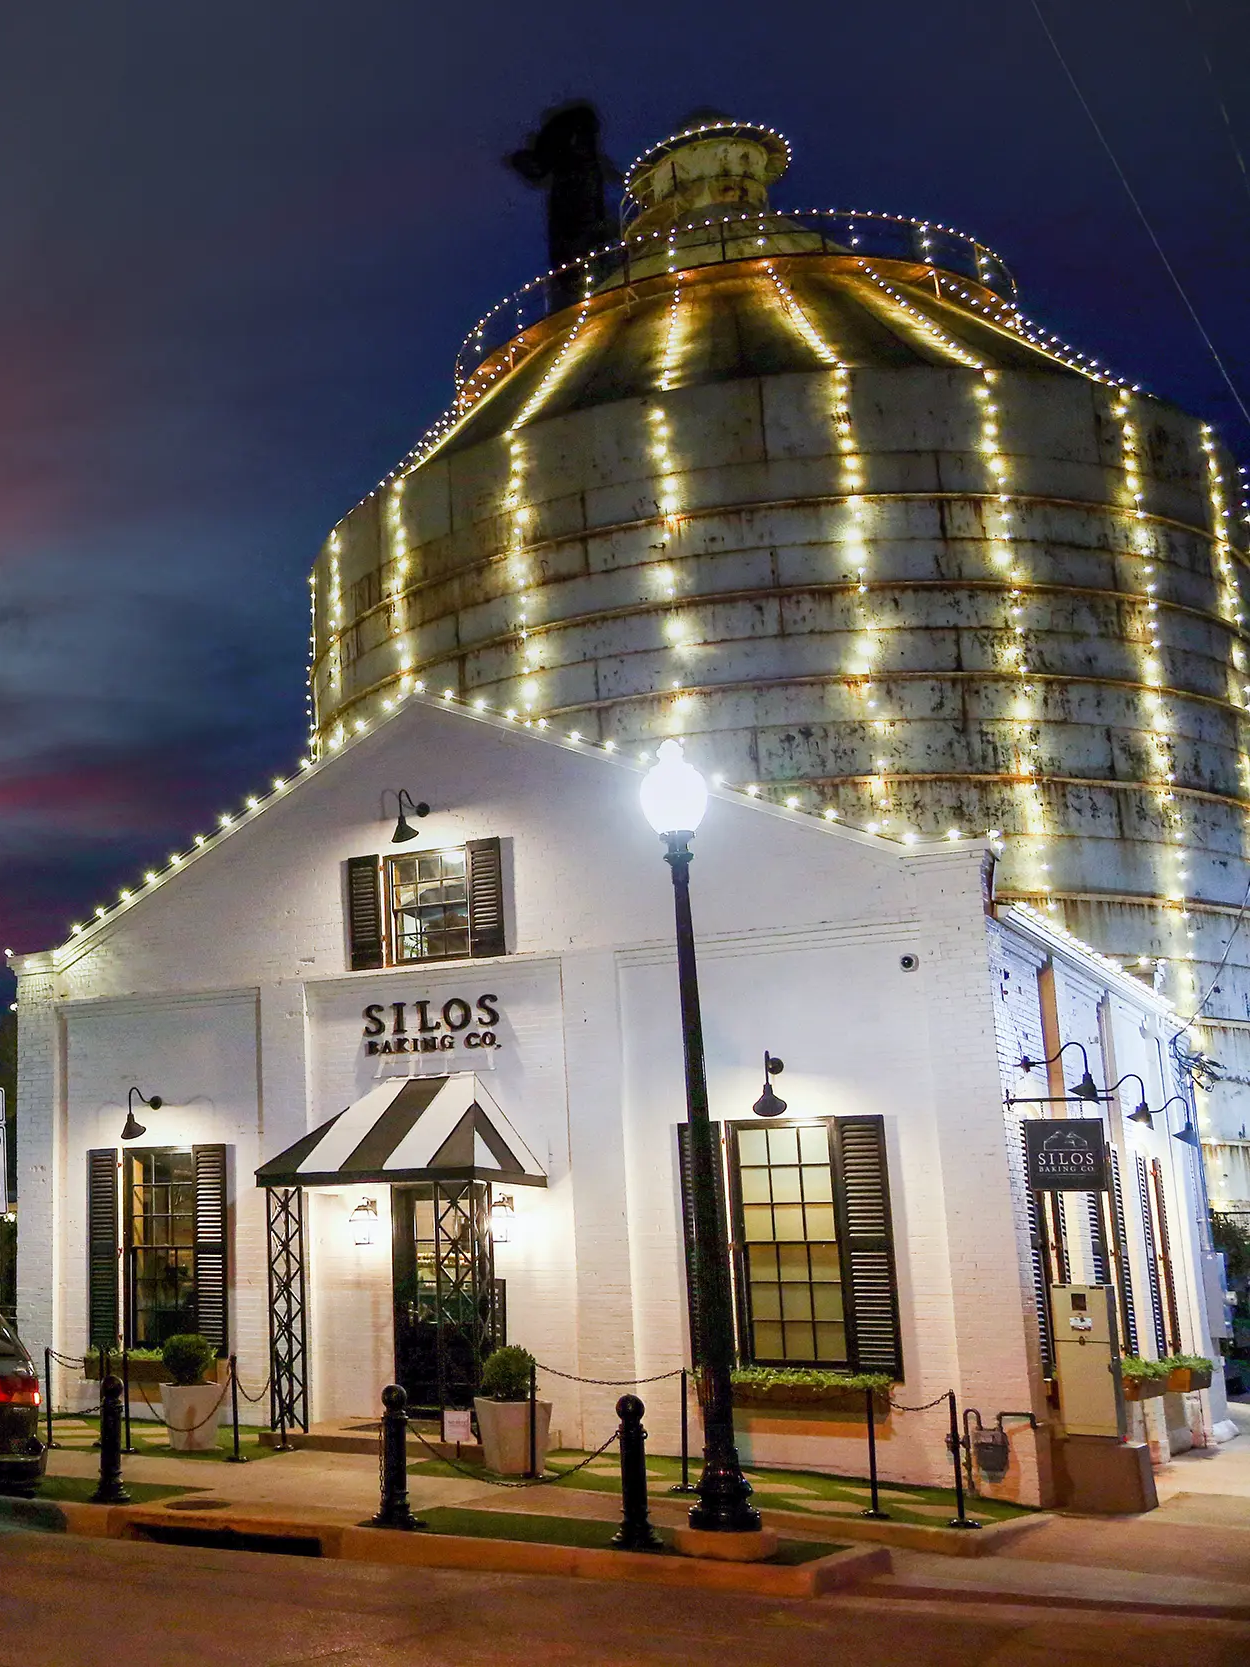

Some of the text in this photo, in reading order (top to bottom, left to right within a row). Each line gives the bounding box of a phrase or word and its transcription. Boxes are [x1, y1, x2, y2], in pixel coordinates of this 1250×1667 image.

[362, 994, 500, 1037] SILOS
[364, 1031, 502, 1057] BAKING CO.
[1038, 1152, 1094, 1165] SILOS
[1038, 1165, 1076, 1173] BAKING
